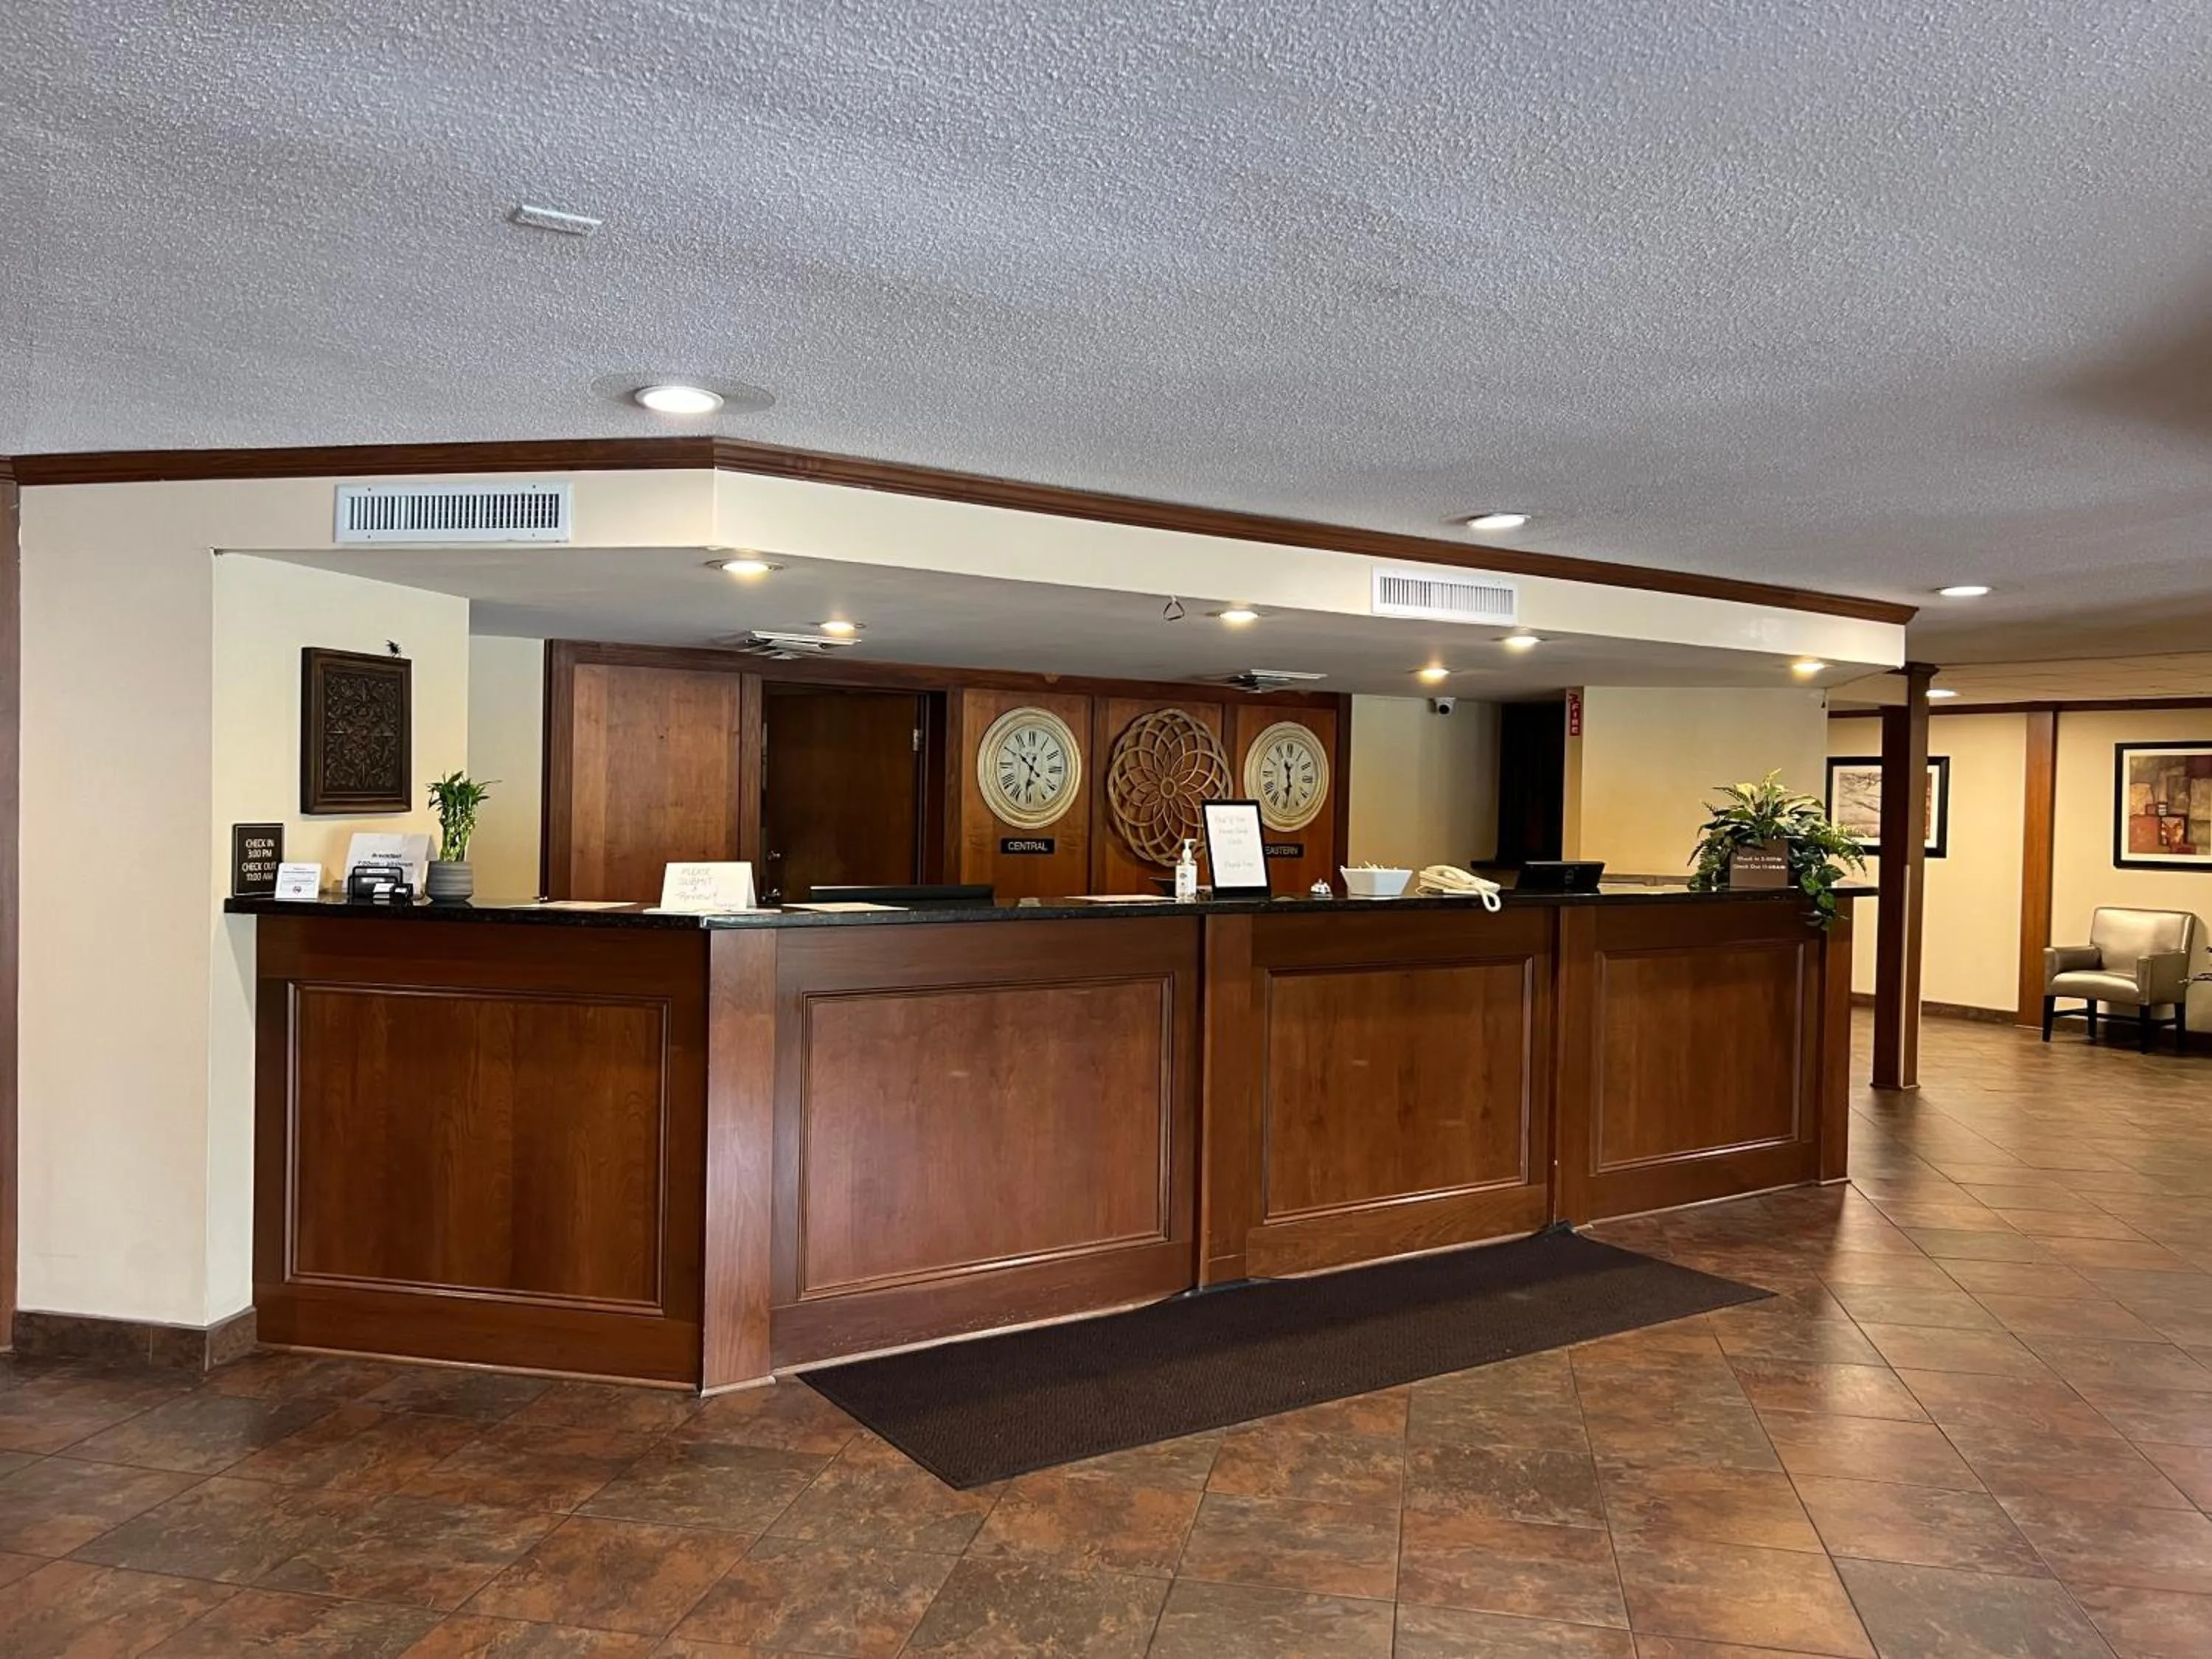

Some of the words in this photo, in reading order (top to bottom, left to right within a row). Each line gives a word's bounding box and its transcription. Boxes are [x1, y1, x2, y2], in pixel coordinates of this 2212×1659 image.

[246, 838, 266, 848] CHECK
[267, 838, 274, 847] IN
[1008, 841, 1047, 852] CENTRAL
[247, 849, 262, 858] 3:00
[1265, 846, 1298, 855] EASTERN
[241, 861, 262, 872] CHECK
[263, 861, 276, 870] OUT
[262, 872, 274, 881] AM
